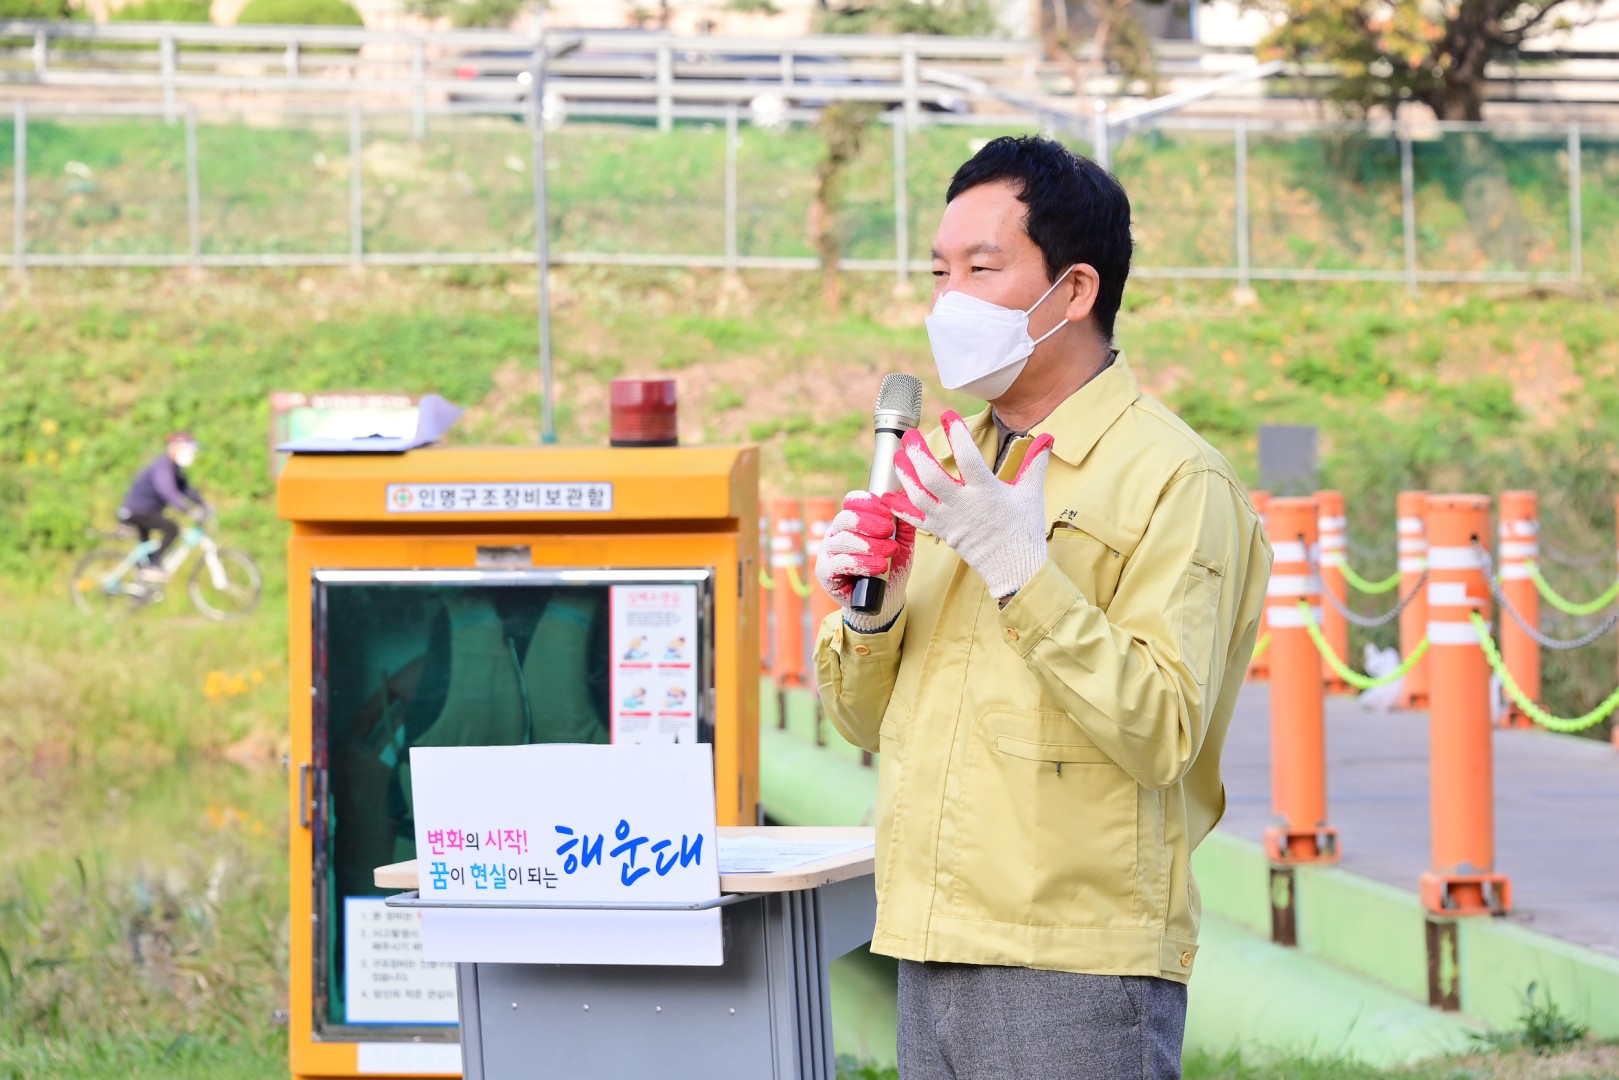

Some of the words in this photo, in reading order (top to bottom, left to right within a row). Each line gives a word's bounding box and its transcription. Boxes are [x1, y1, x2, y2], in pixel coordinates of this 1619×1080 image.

[418, 487, 604, 508] 인명구조장비보관함
[427, 829, 480, 855] 변화의
[485, 829, 528, 855] 시작!
[554, 819, 704, 886] 해운대
[429, 862, 465, 890] 꿈이
[470, 863, 523, 890] 현실이
[527, 867, 559, 889] 되는
